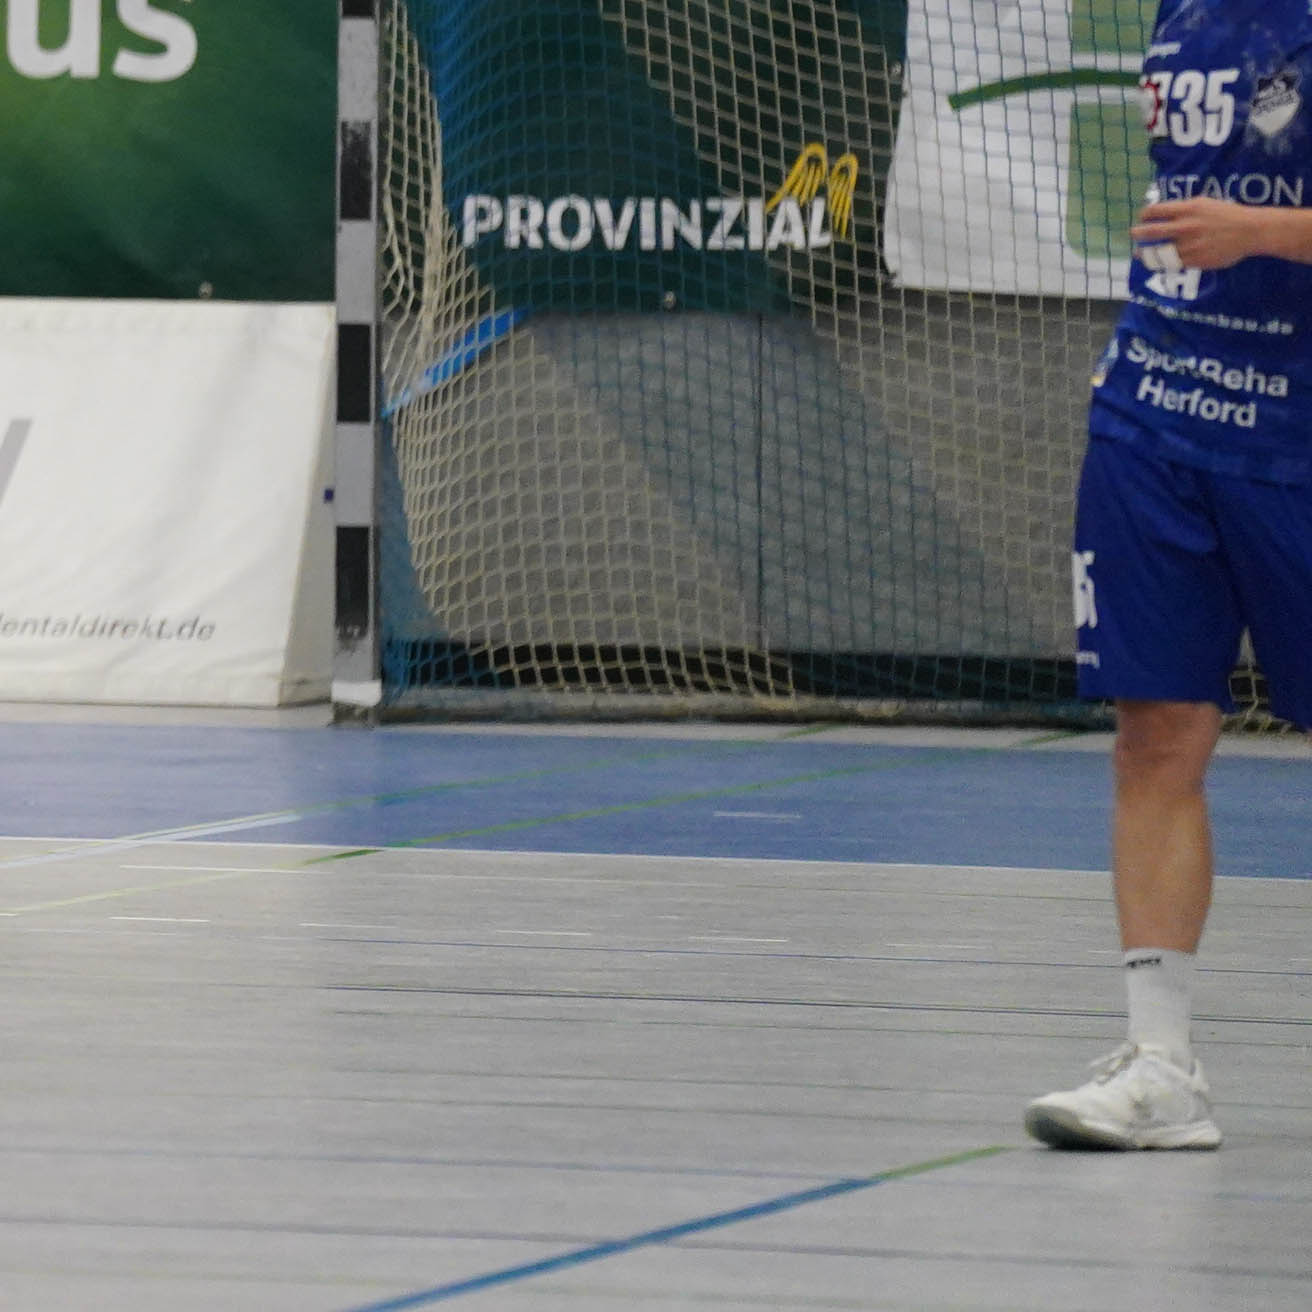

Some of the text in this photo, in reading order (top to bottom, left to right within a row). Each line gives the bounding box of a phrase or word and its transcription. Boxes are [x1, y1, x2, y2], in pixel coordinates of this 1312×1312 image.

[1168, 68, 1241, 148] 35
[462, 194, 833, 252] PROVINZIAL
[1136, 374, 1257, 429] Herford
